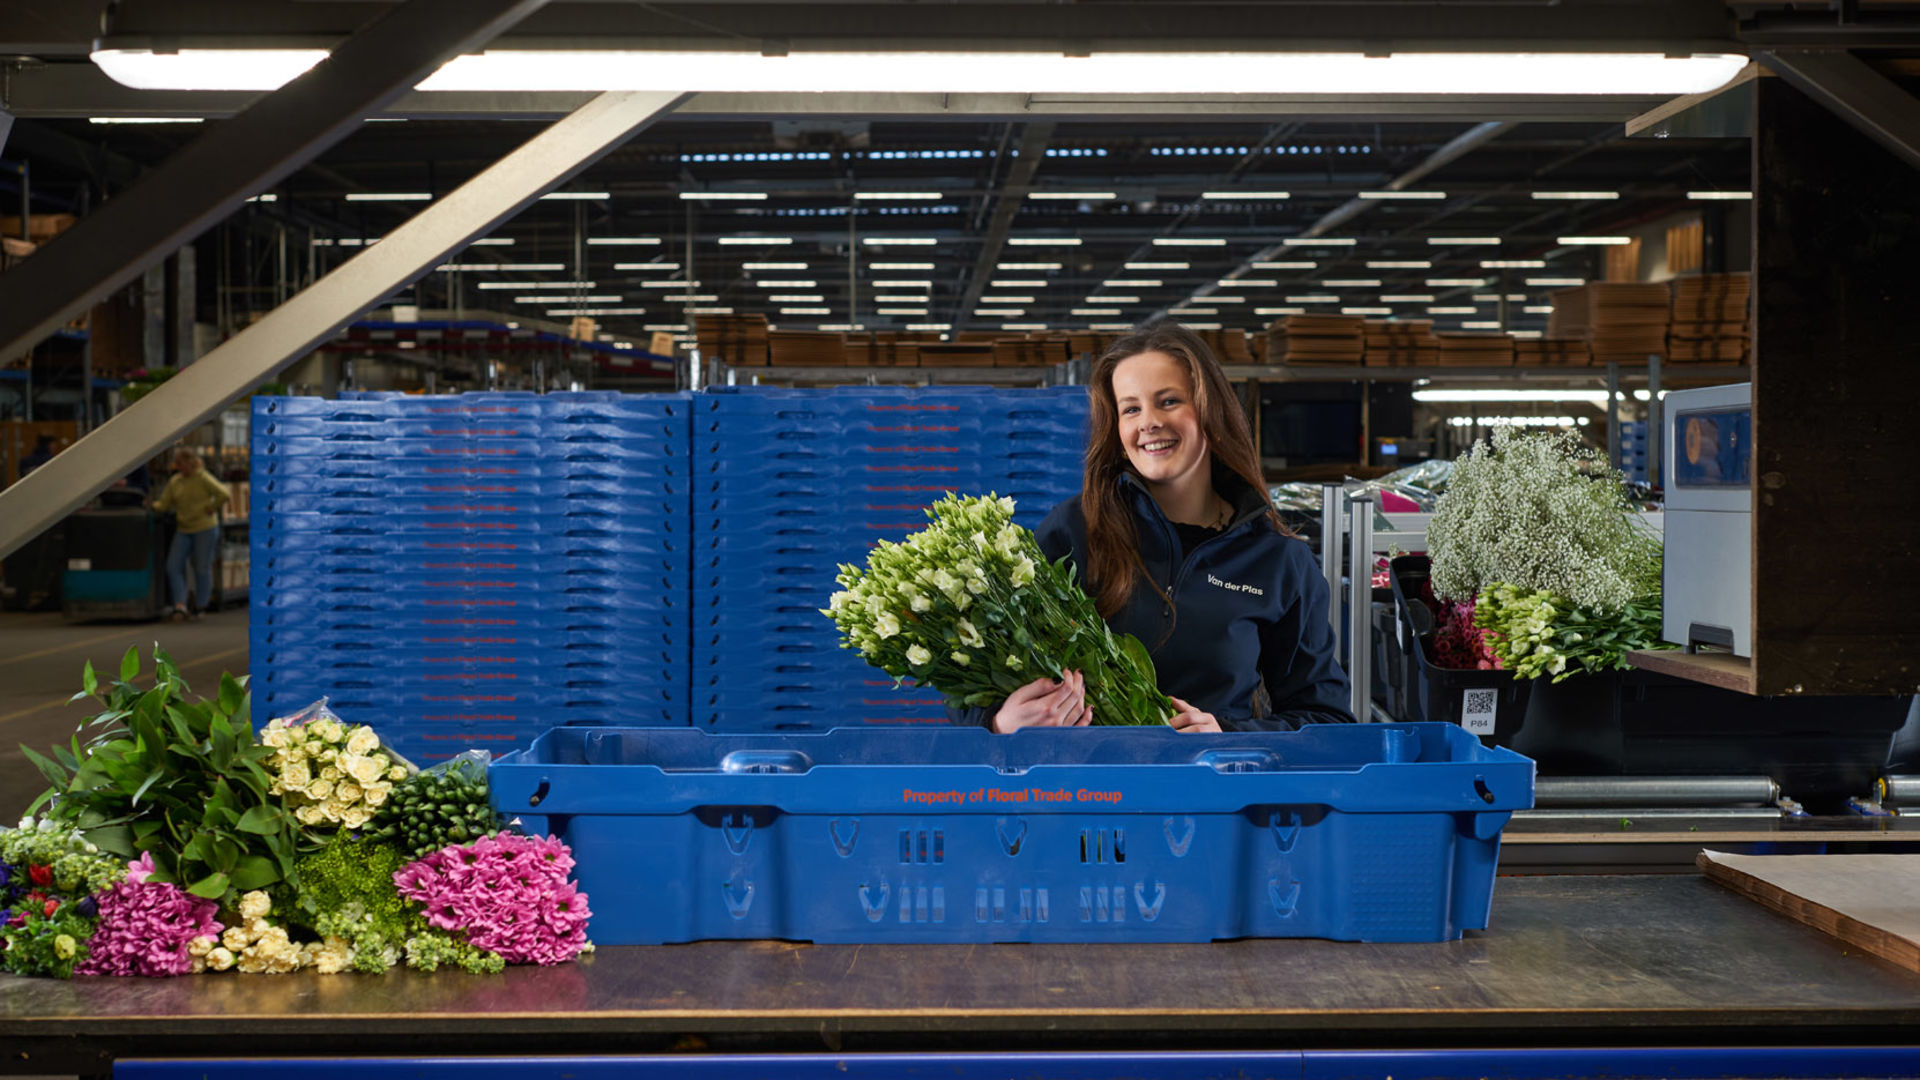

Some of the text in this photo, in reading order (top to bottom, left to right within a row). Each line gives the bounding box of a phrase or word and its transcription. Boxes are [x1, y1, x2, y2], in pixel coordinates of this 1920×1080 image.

[1207, 573, 1264, 596] Van der Plas
[903, 788, 1123, 805] Property of Floral Trade Group
